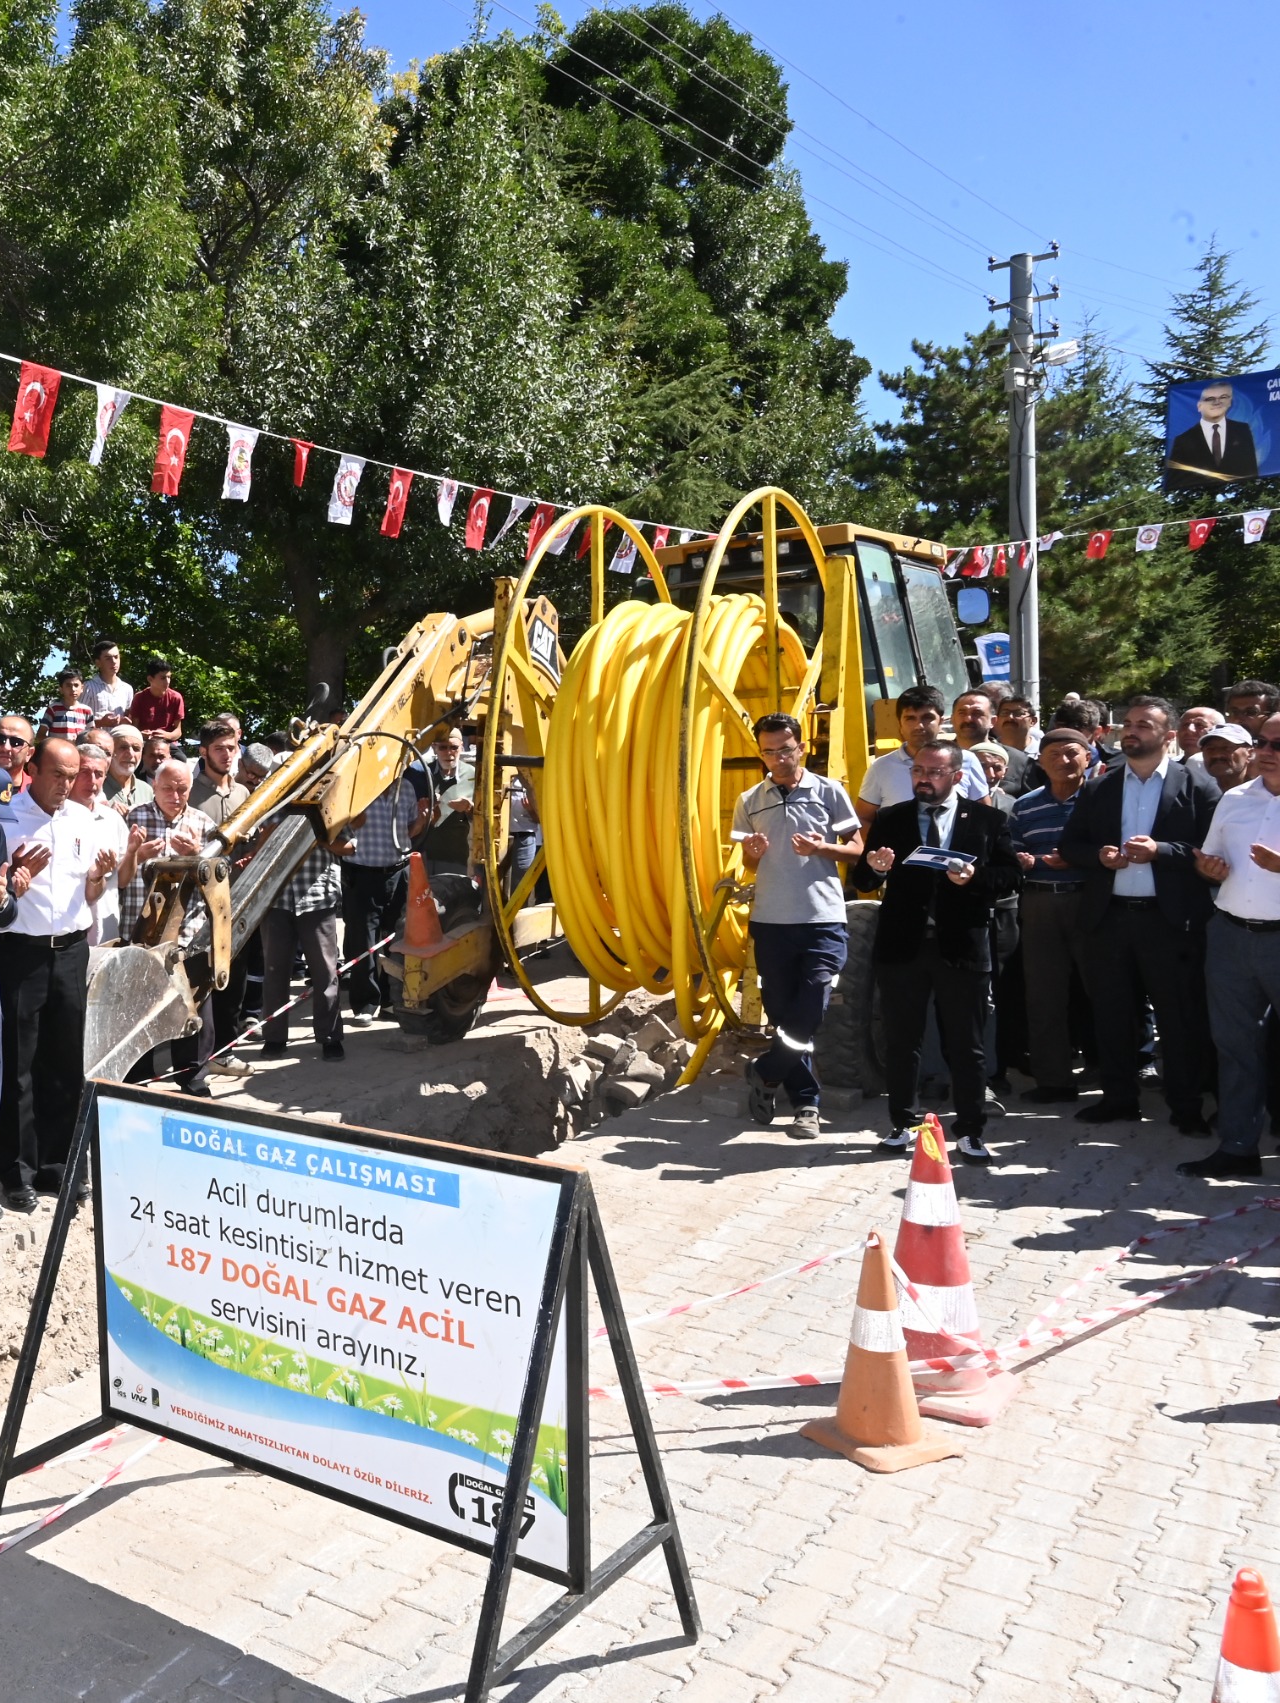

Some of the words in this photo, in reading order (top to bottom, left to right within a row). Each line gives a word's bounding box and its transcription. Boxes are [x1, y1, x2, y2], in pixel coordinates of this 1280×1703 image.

[1267, 379, 1280, 390] ÇA
[533, 619, 556, 662] CAT
[179, 1127, 247, 1158] DOĞAL
[255, 1143, 297, 1167] GAZ
[306, 1154, 436, 1197] ÇALIŞMASI
[207, 1177, 246, 1209] Acil
[256, 1187, 404, 1246] durumlarda
[129, 1197, 156, 1224] 24
[163, 1210, 211, 1239] saat
[219, 1216, 329, 1269] kesintisiz
[338, 1247, 429, 1295] hizmet
[438, 1278, 522, 1318] veren
[166, 1243, 212, 1275] 187
[222, 1259, 318, 1306] DOĞAL
[326, 1287, 387, 1324] GAZ
[397, 1306, 475, 1349] ACİL
[210, 1298, 307, 1344] servisini
[316, 1319, 426, 1378] arayınız.
[170, 1404, 225, 1431] VERDİĞİMİZ
[228, 1424, 310, 1461] RAHATSIZLIKTAN
[313, 1454, 350, 1476] DOLAYI
[353, 1466, 382, 1486] ÖZÜR
[385, 1479, 433, 1505] DİLERİZ.
[466, 1479, 494, 1494] DOĞAL
